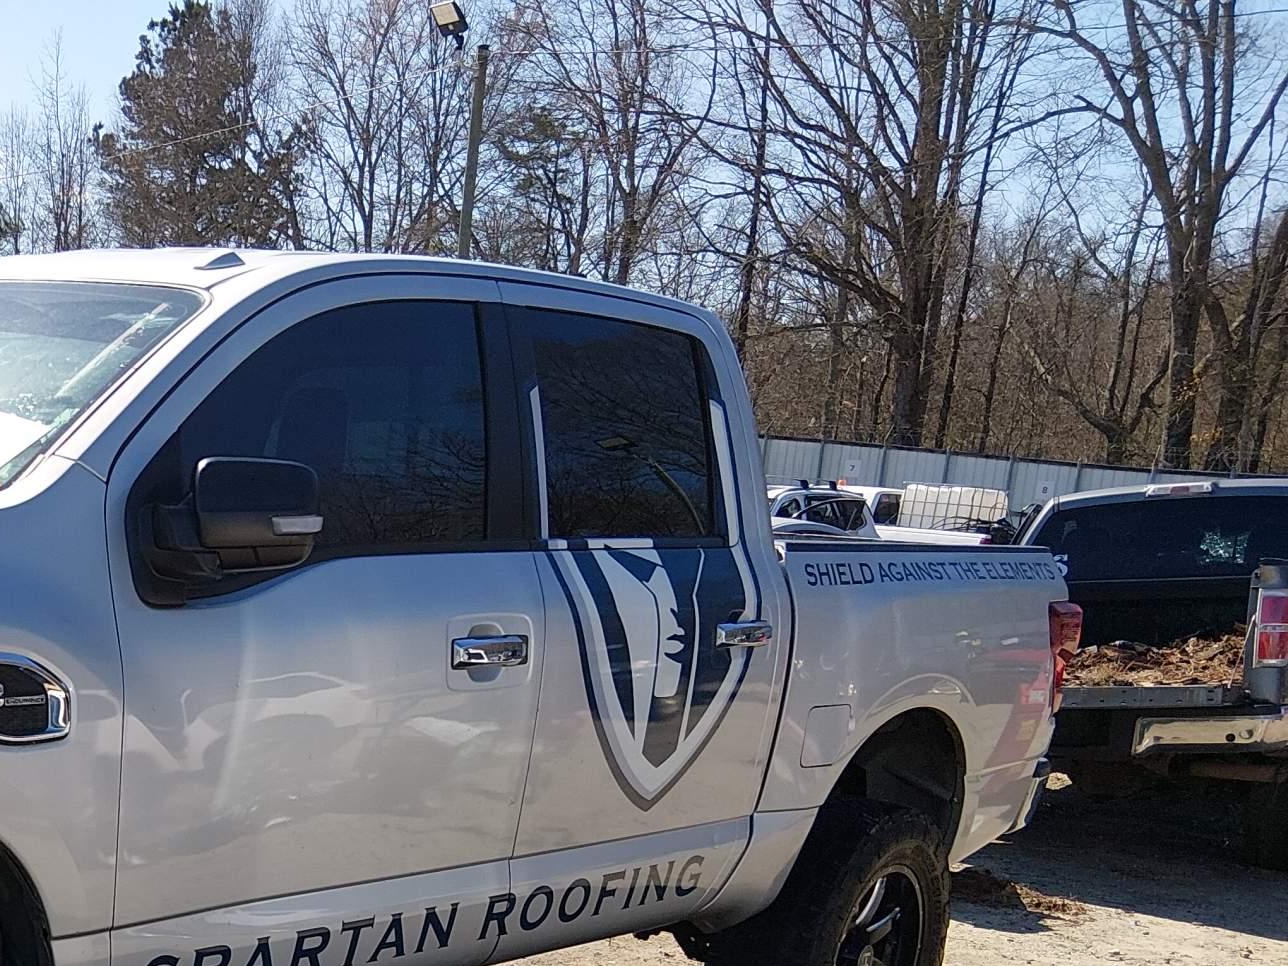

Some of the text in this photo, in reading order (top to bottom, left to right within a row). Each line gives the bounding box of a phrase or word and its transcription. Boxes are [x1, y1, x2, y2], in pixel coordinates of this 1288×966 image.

[804, 561, 1056, 586] SHIELD AGAINST THE ELEMENTS
[477, 855, 705, 941] ROOFING
